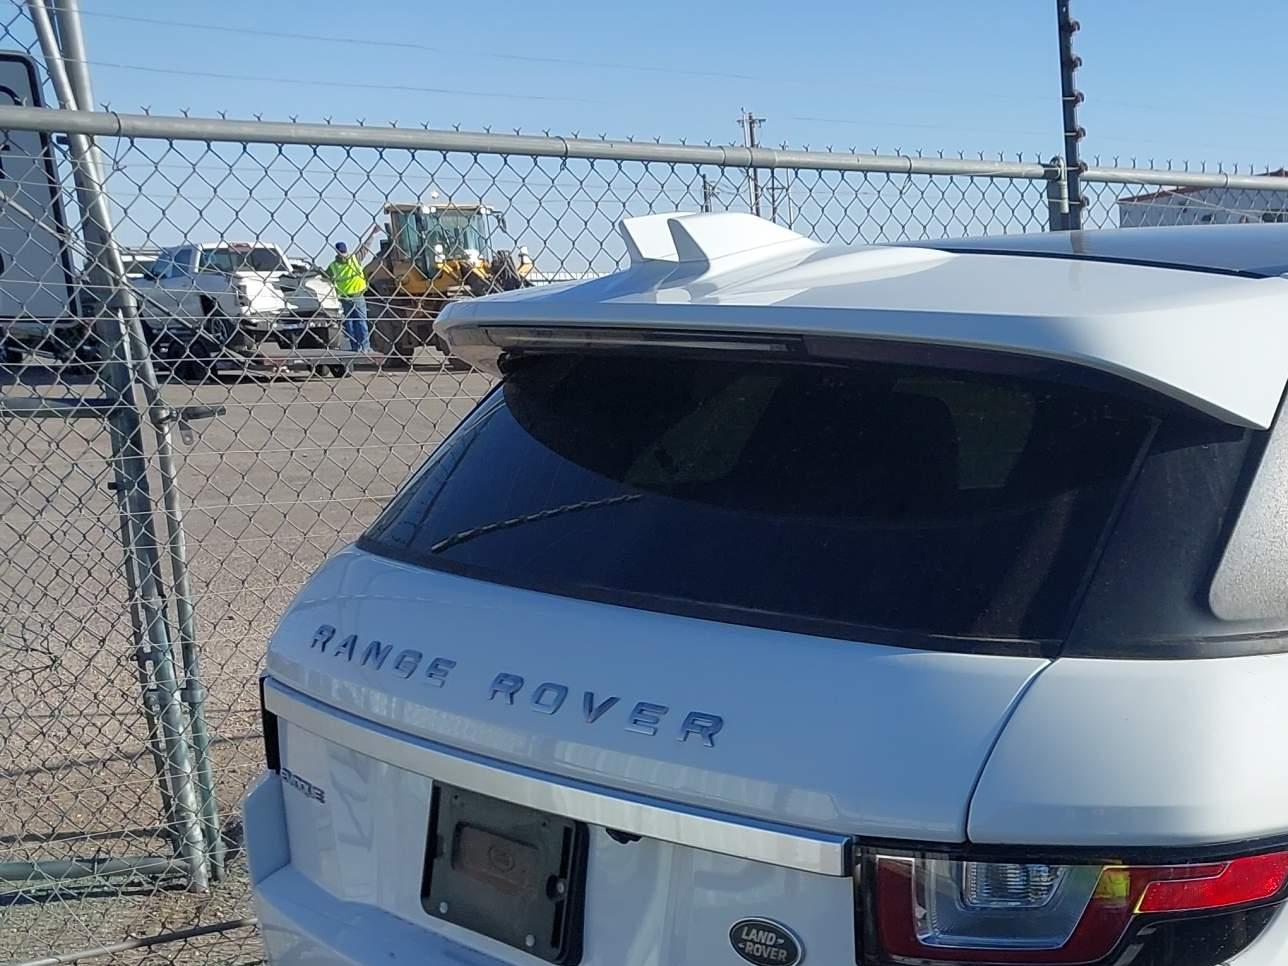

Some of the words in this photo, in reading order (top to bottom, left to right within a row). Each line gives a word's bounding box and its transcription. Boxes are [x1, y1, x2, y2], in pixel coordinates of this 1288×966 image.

[310, 623, 457, 688] RANGE
[487, 671, 724, 748] ROVER
[741, 926, 777, 946] LAND
[744, 941, 788, 961] ROVER
